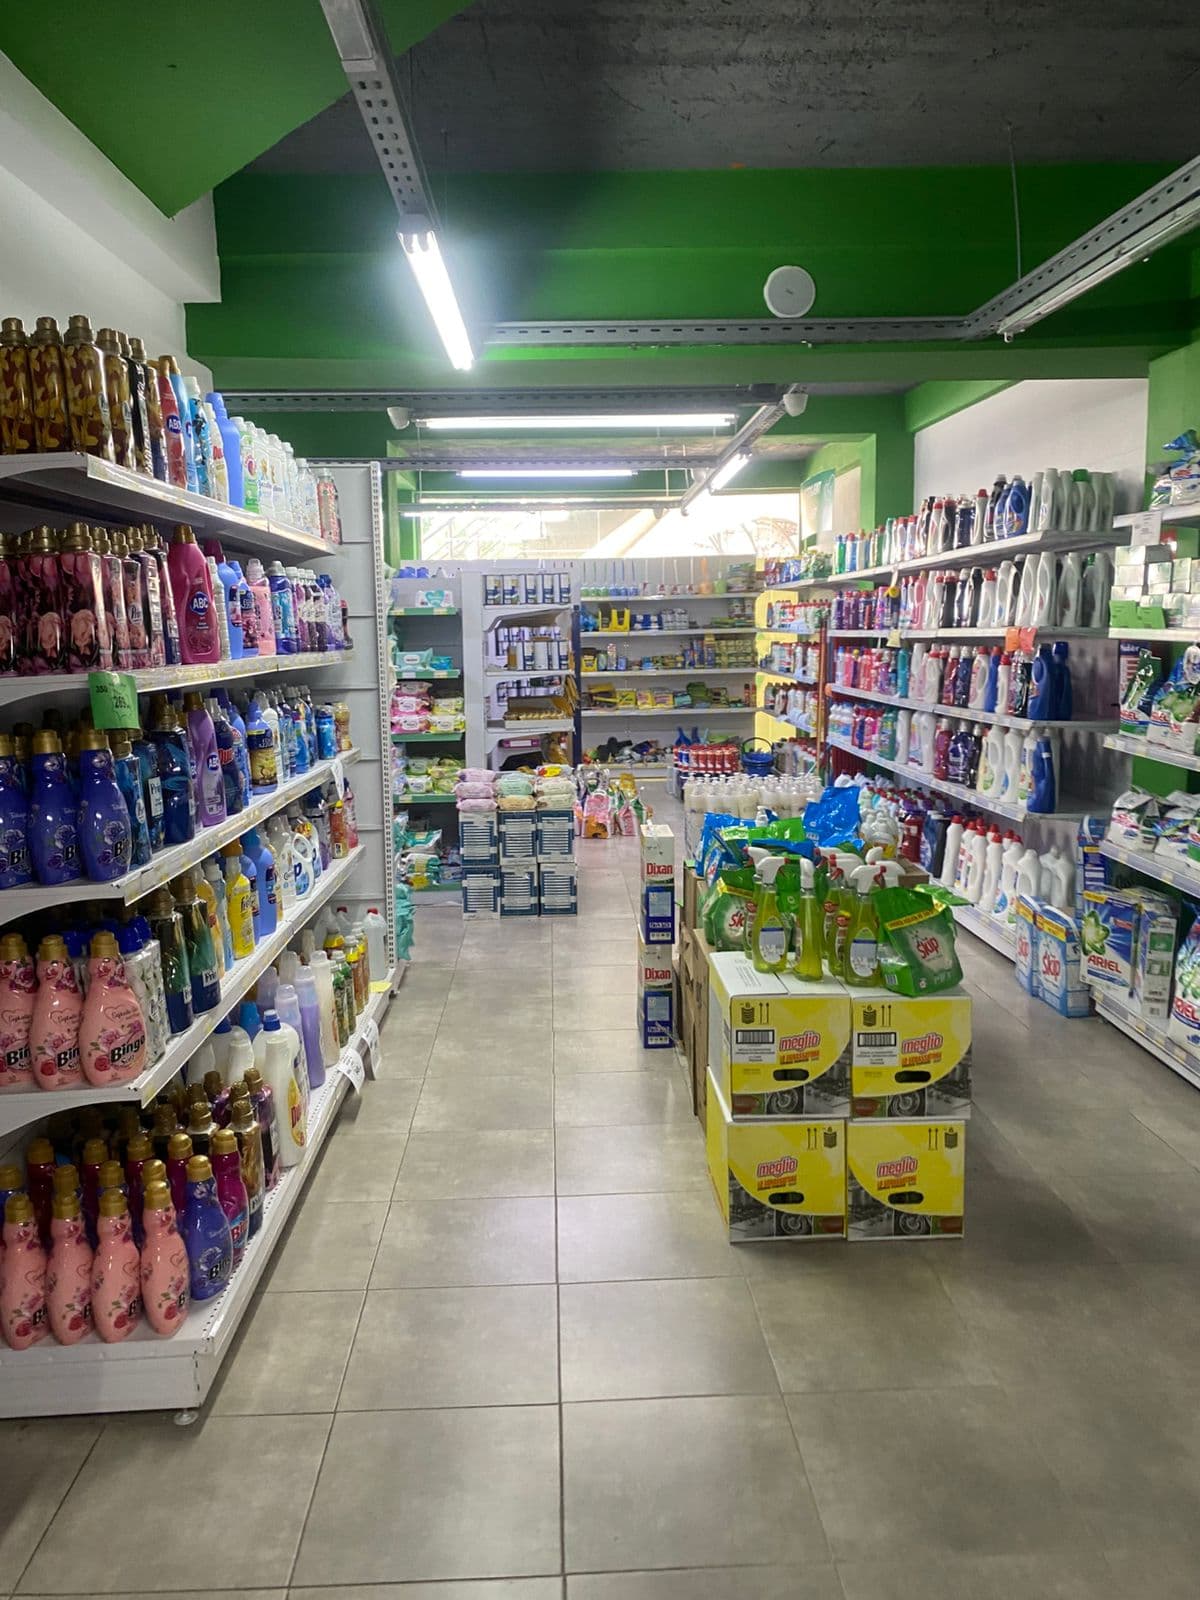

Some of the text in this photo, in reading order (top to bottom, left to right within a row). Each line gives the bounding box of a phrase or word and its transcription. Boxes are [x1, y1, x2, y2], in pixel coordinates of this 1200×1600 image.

[192, 597, 209, 610] ABC
[646, 862, 673, 876] Dixan
[917, 937, 939, 959] Skip
[644, 967, 671, 981] Dixan
[1042, 951, 1061, 982] Skip
[1087, 954, 1122, 974] ARIEL
[111, 1034, 145, 1063] Bingo
[780, 1031, 820, 1052] meglio
[902, 1033, 943, 1054] meglio
[757, 1156, 798, 1177] meglio
[877, 1156, 918, 1177] meglio
